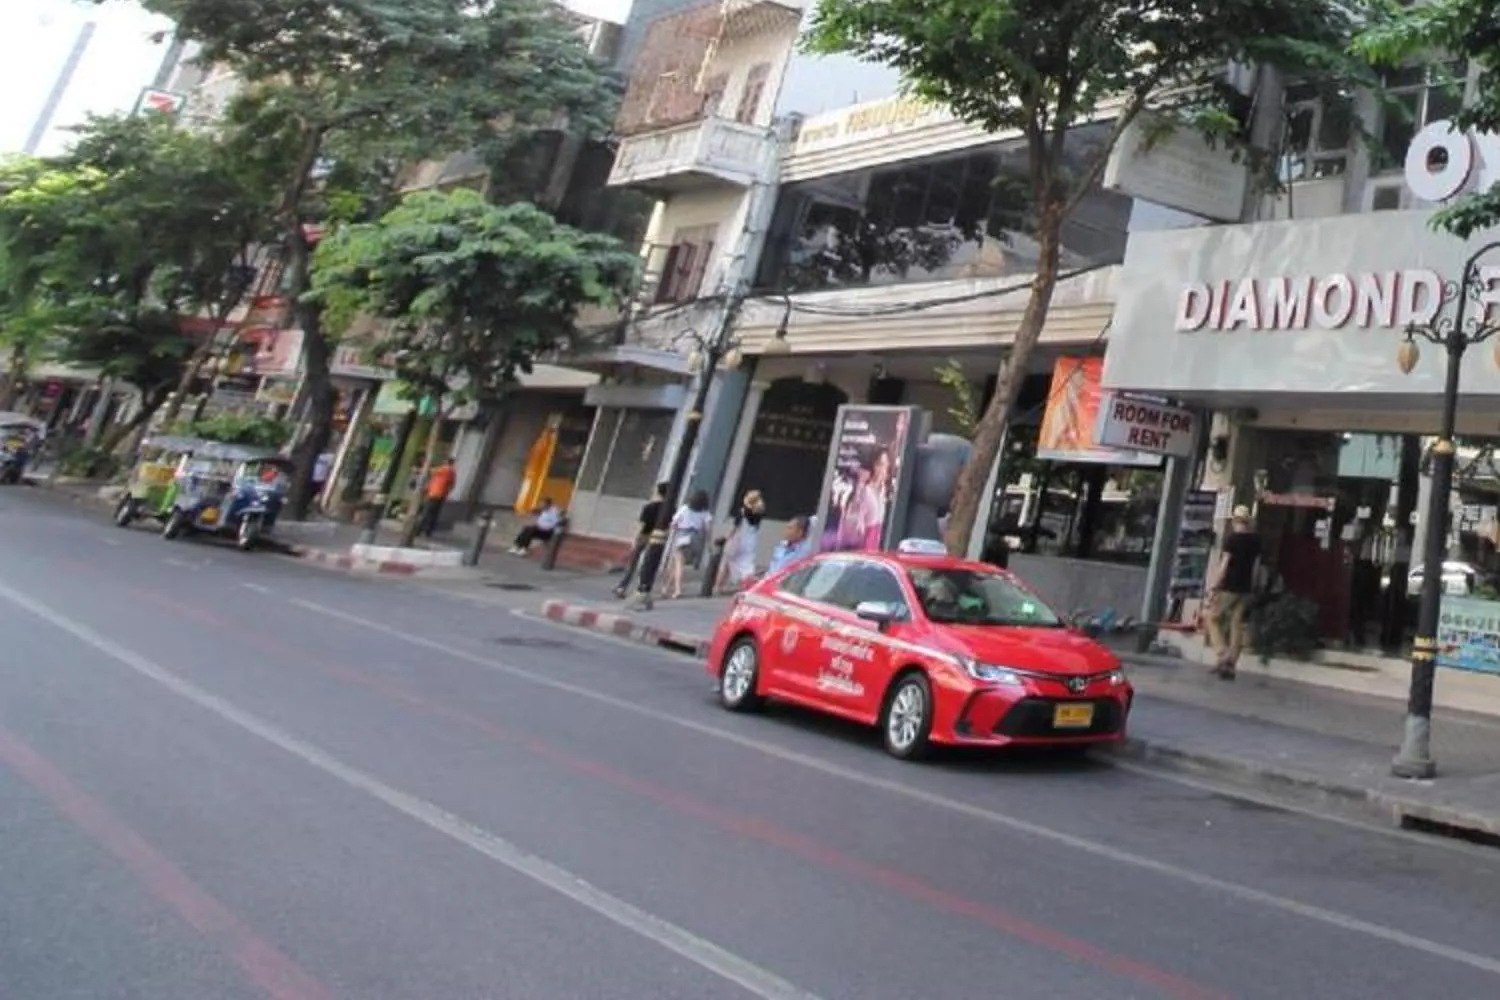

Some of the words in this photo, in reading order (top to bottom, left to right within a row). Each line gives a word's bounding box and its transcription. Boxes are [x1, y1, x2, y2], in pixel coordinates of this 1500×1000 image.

[1174, 269, 1446, 333] DIAMOND
[1113, 402, 1160, 427] ROOM
[1160, 411, 1191, 434] FOR
[1127, 427, 1172, 449] RENT
